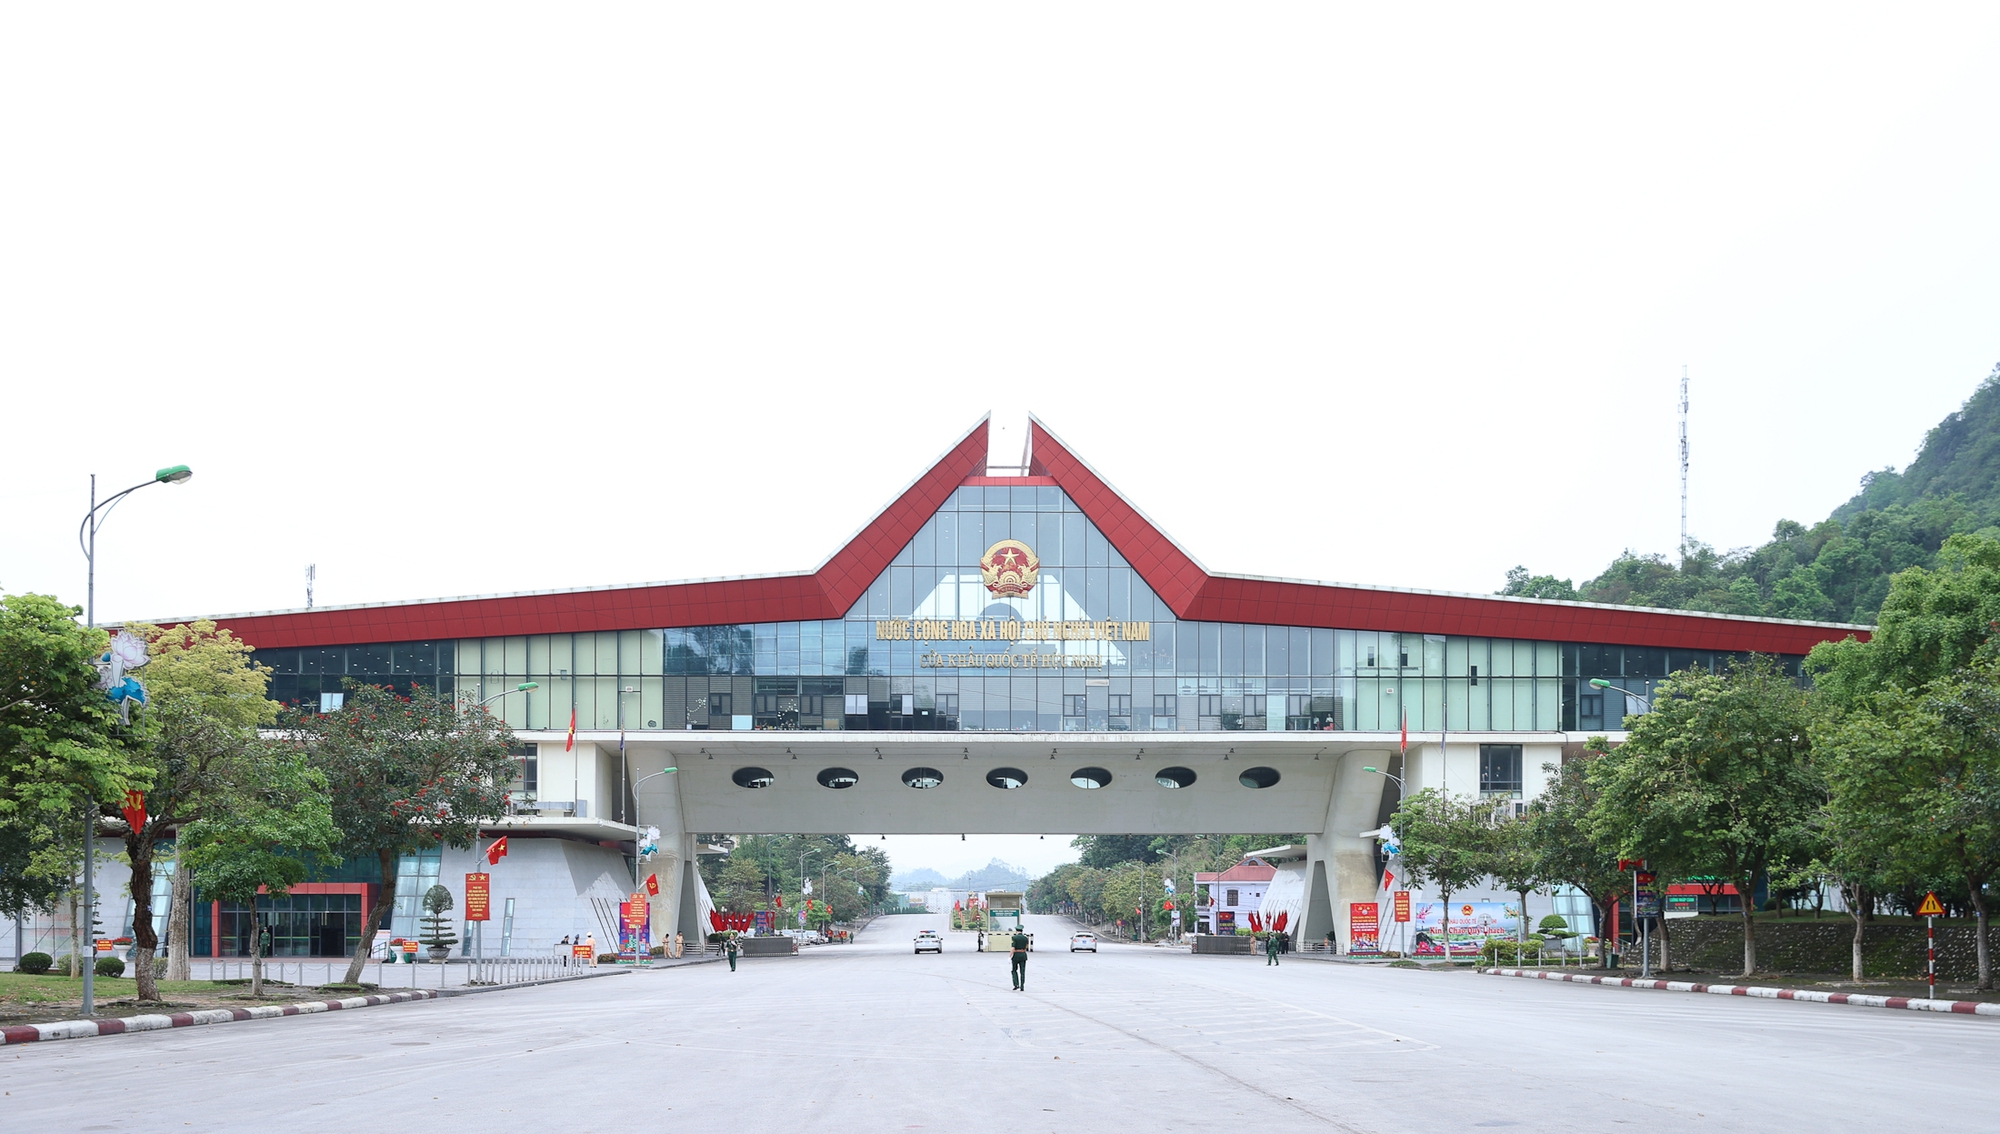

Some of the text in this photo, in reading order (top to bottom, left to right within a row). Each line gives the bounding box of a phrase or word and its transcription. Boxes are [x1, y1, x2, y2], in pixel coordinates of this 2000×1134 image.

[876, 615, 1150, 646] NƯỚC CỘNG HÒA XÃ HỘI CHỦ NGHĨA VIỆT NAM
[920, 648, 944, 668] CỬA
[947, 645, 983, 668] KHẨU
[985, 647, 1019, 669] QUỐC
[1022, 648, 1038, 668] TẾ
[1071, 654, 1103, 672] NGHỊ
